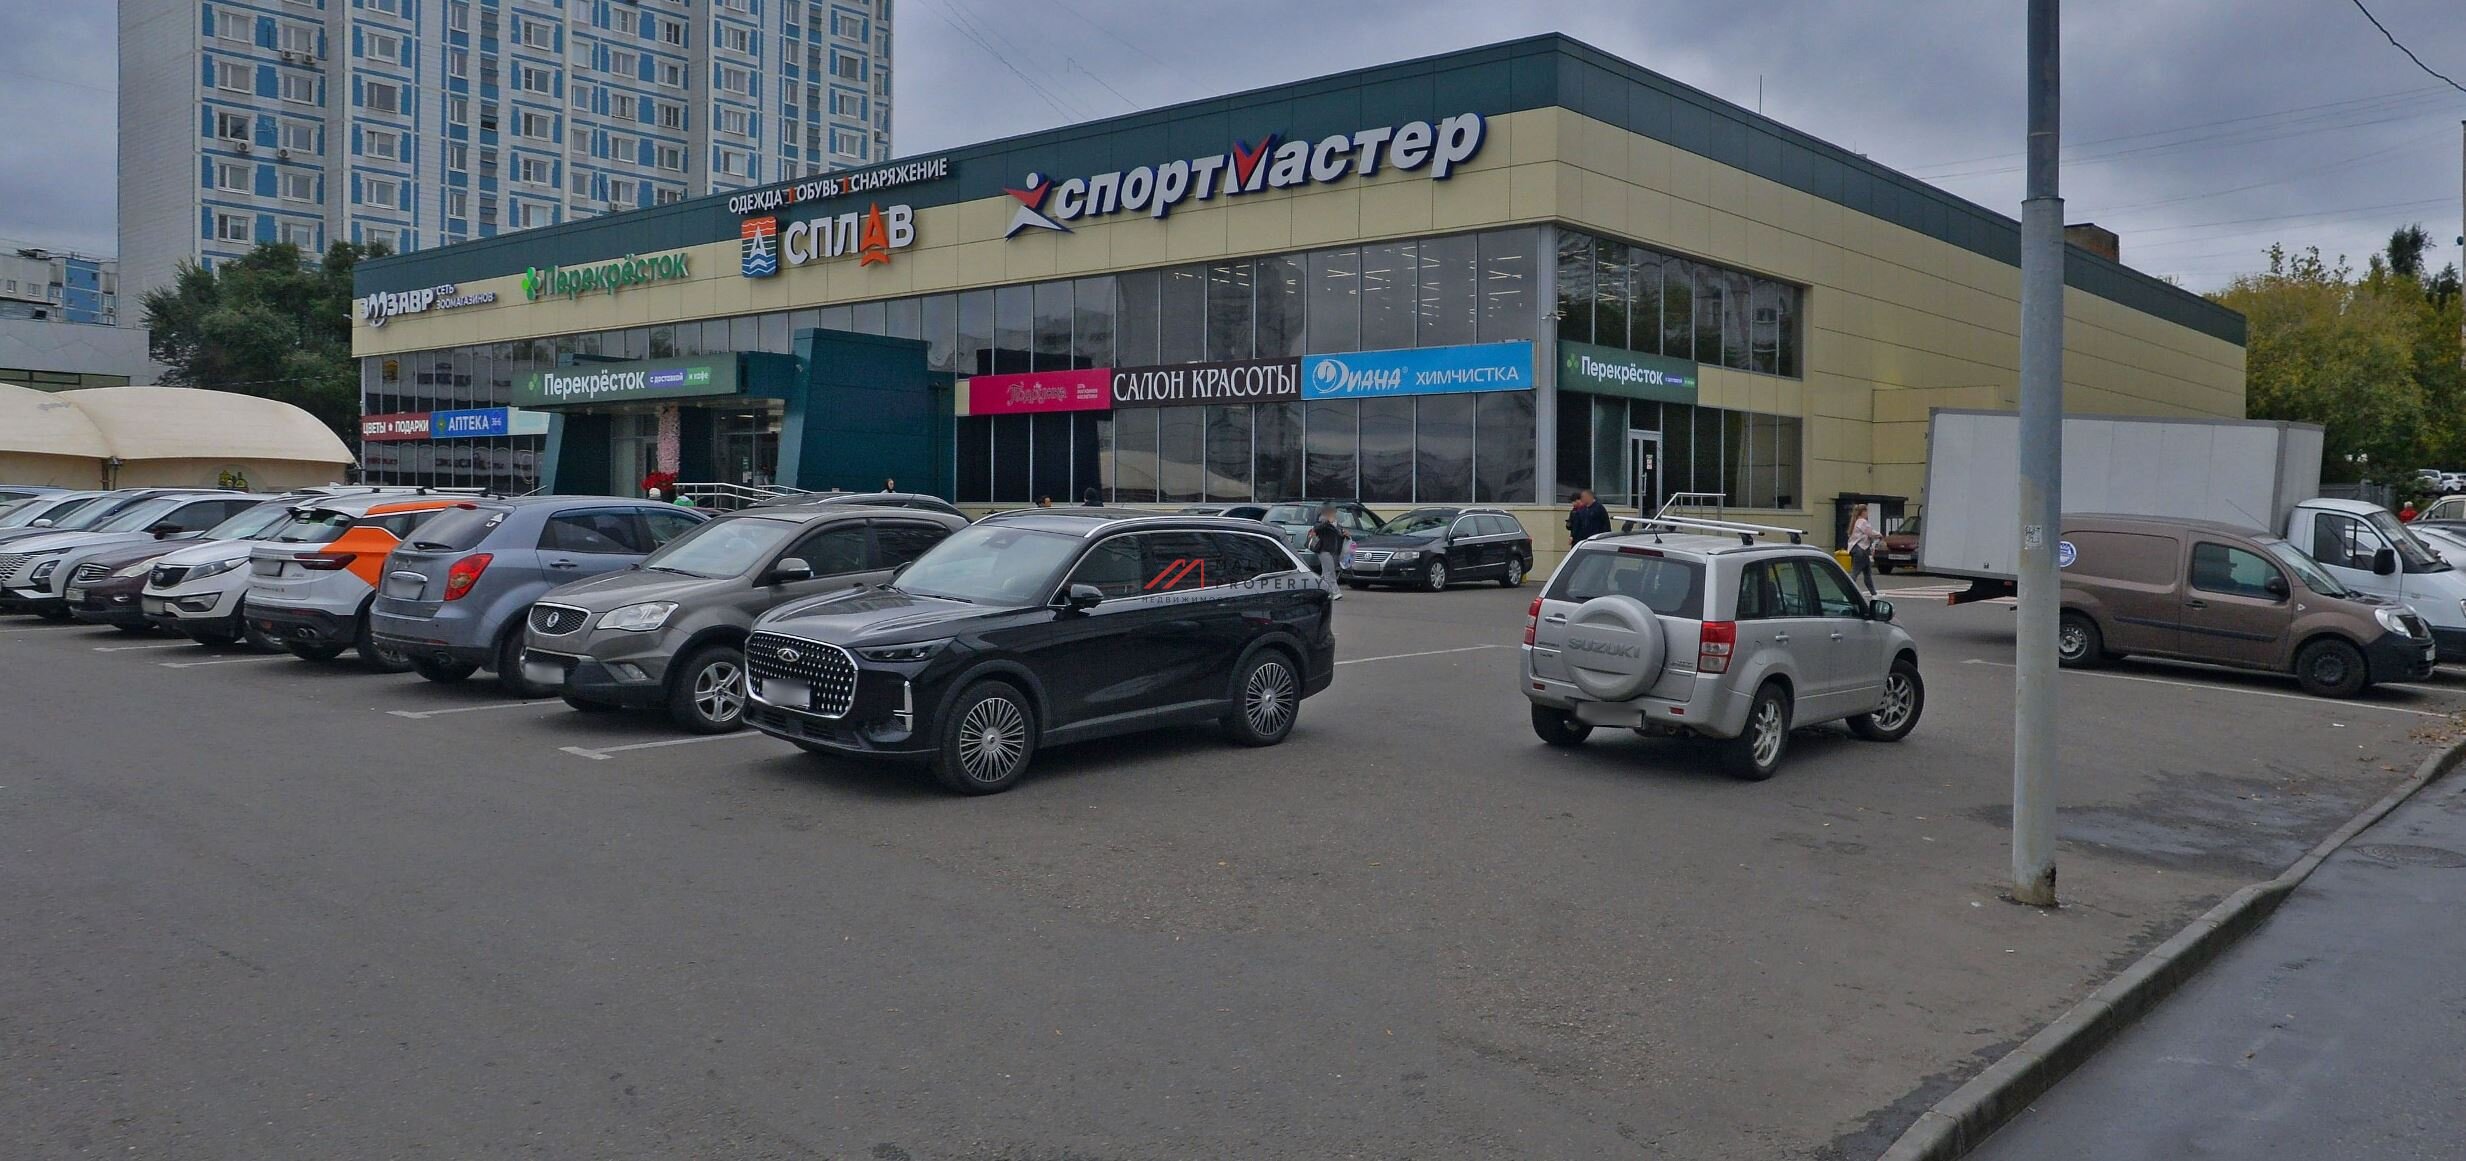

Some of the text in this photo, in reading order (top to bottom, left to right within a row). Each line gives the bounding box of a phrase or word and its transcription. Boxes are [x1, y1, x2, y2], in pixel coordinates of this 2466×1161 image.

[728, 157, 949, 214] ОДЕЖДА ОБУВЬ СНАРЯЖЕНИЕ
[784, 202, 917, 267] СПЛАВ
[436, 284, 455, 295] СЕТЬ
[543, 252, 689, 301] Перекрёсток
[543, 369, 646, 400] Перекрёсток
[1113, 371, 1185, 402] САЛОН
[1191, 364, 1297, 399] КРАСОТЫ
[1415, 365, 1519, 386] ХИМЧИСТКА
[1581, 355, 1664, 385] Перекрёсток
[362, 419, 429, 435] ЦВЕТЫ ПОДАРКИ
[448, 414, 490, 431] АПТЕКА
[1567, 638, 1641, 659] SUZUKI
